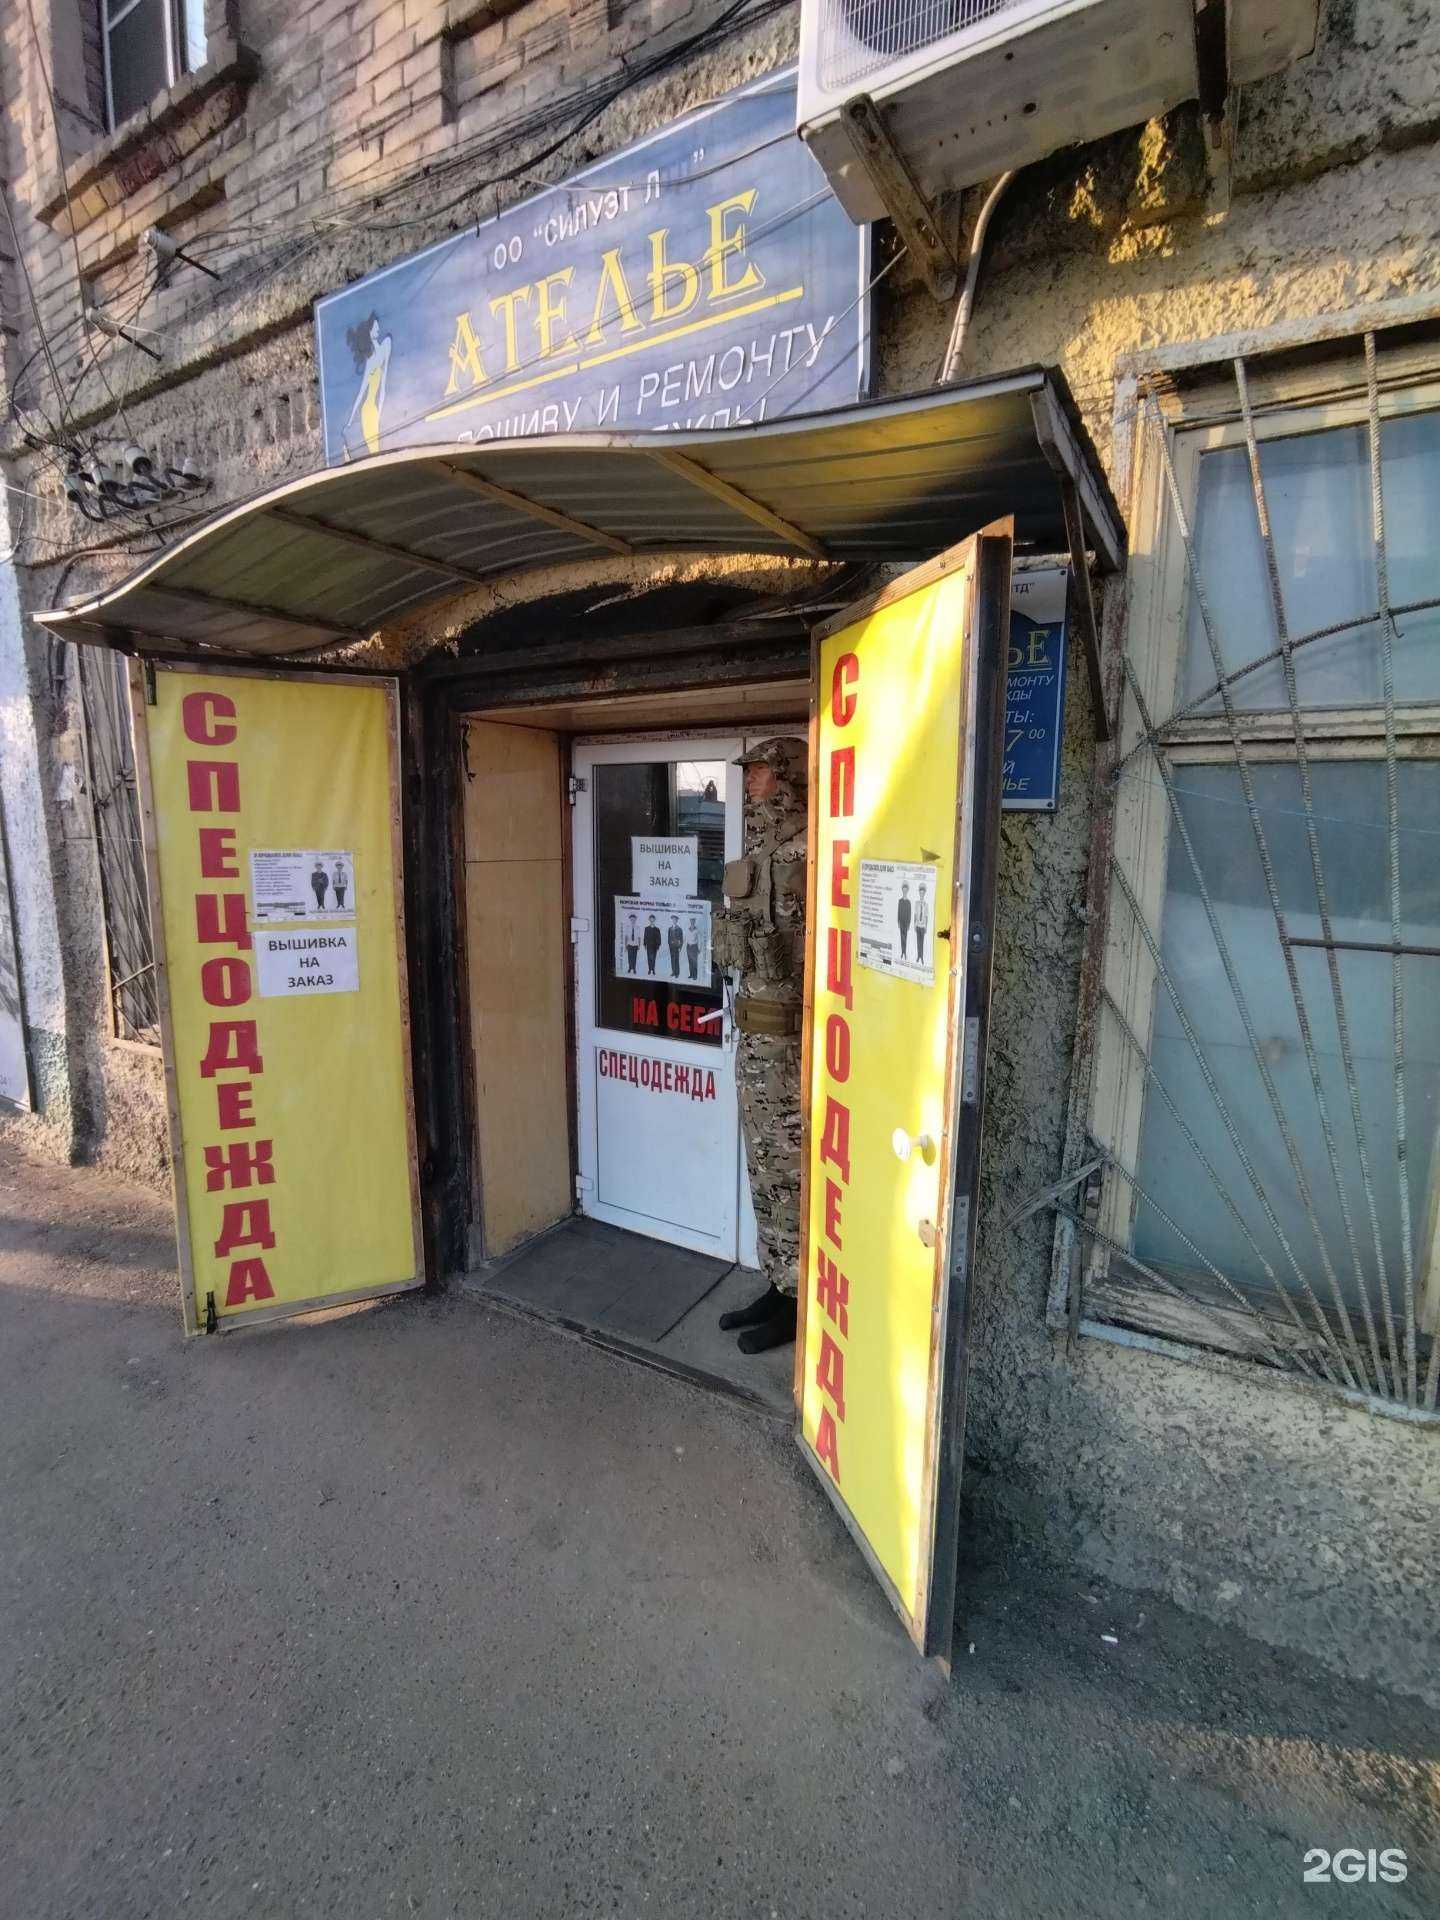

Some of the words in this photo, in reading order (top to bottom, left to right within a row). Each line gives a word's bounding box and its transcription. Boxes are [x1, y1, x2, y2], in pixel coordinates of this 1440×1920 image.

[444, 187, 766, 396] АТЕЛЬЕ
[599, 384, 620, 426] И
[636, 315, 834, 416] РЕМОНТУ
[639, 843, 691, 855] ВЫШИВКА
[658, 861, 672, 870] НА
[649, 877, 680, 887] ЗАКАЗ
[268, 937, 348, 952] ВЫШИВКА
[299, 957, 320, 968] НА
[287, 975, 334, 988] ЗАКАЗ
[182, 692, 276, 1306] СПЕЦОДЕЖДА
[632, 998, 659, 1025] НА
[599, 1050, 716, 1102] СПЕЦОДЕЖДА
[814, 652, 860, 1486] СПЕЦОДЕЖДА
